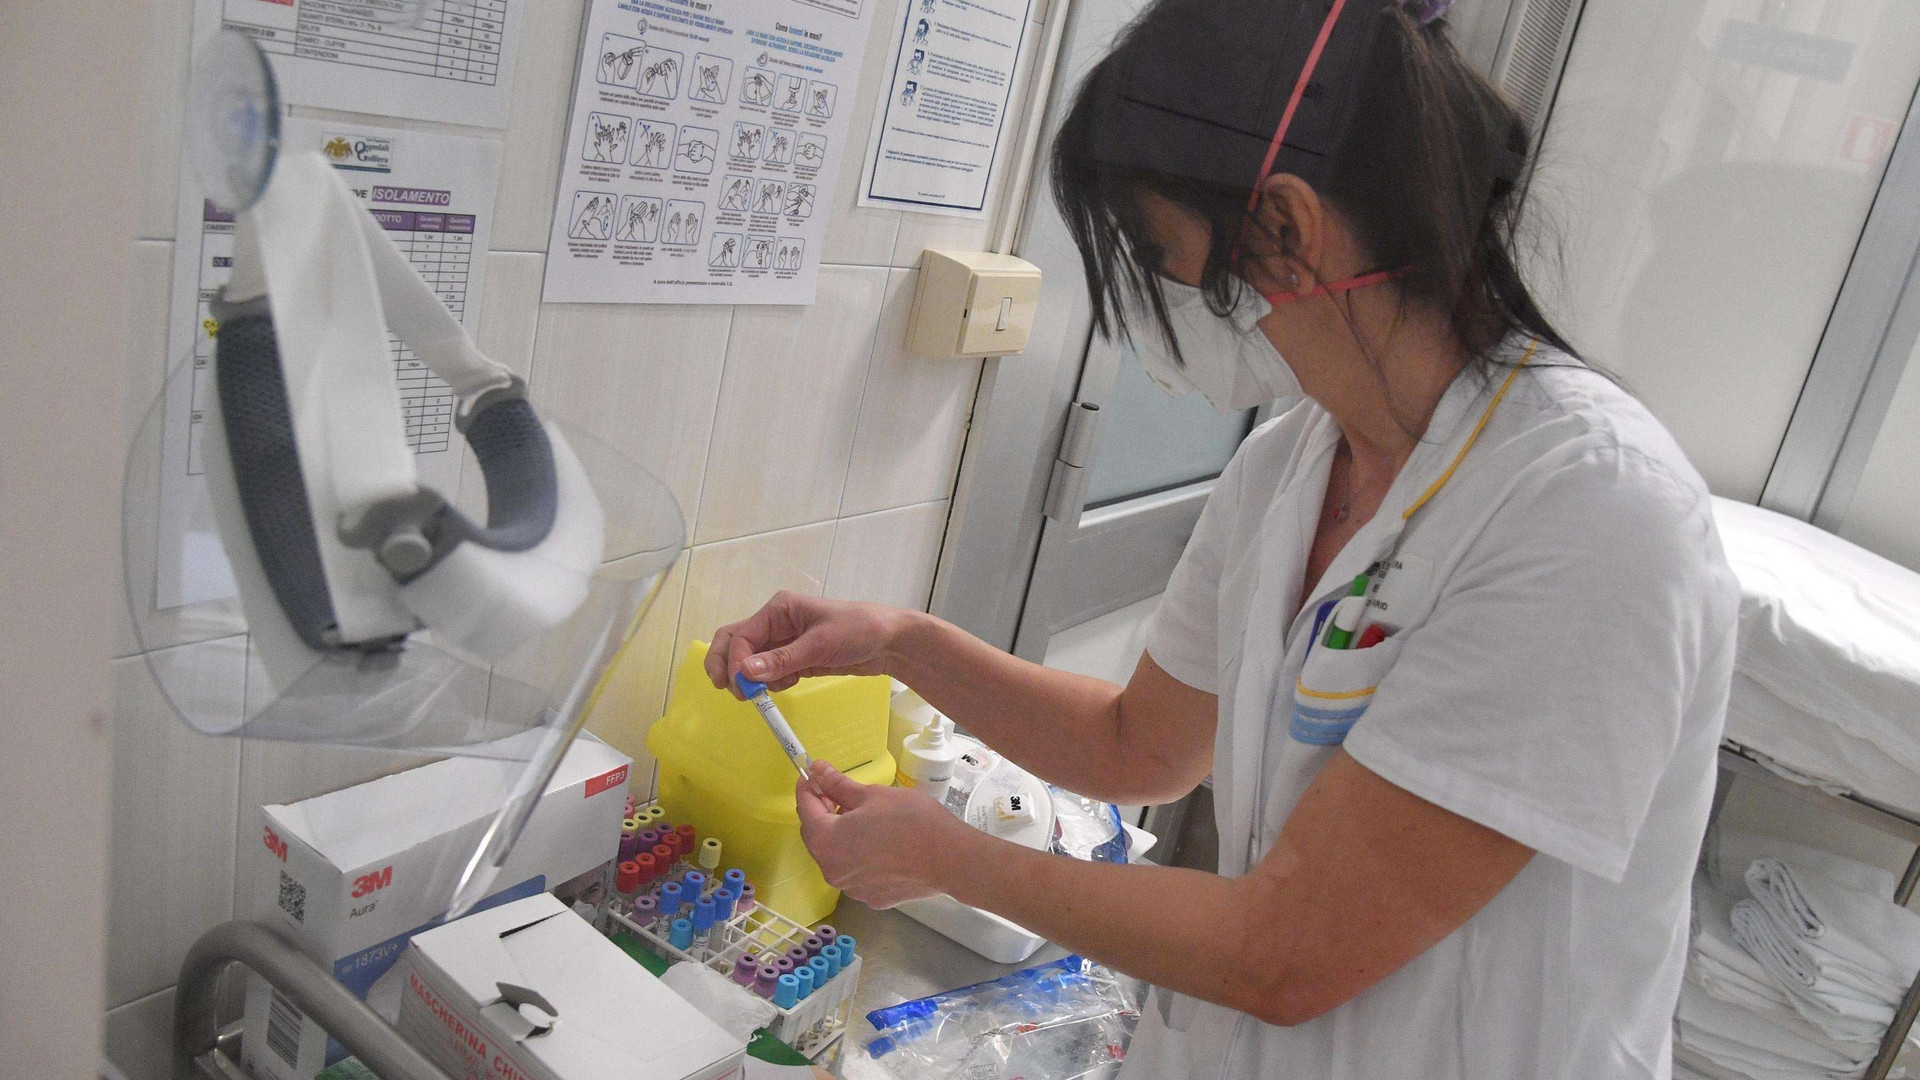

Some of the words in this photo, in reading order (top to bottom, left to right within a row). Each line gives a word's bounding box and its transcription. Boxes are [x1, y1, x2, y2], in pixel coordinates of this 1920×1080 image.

[373, 188, 450, 204] ISOLAMENTO
[961, 754, 979, 766] 3M
[606, 771, 625, 785] FFP3
[1010, 796, 1022, 811] 3M
[263, 826, 288, 863] 3M
[351, 866, 393, 898] 3M
[409, 972, 487, 1061] MASCHERINA
[494, 1055, 527, 1080] CHI
